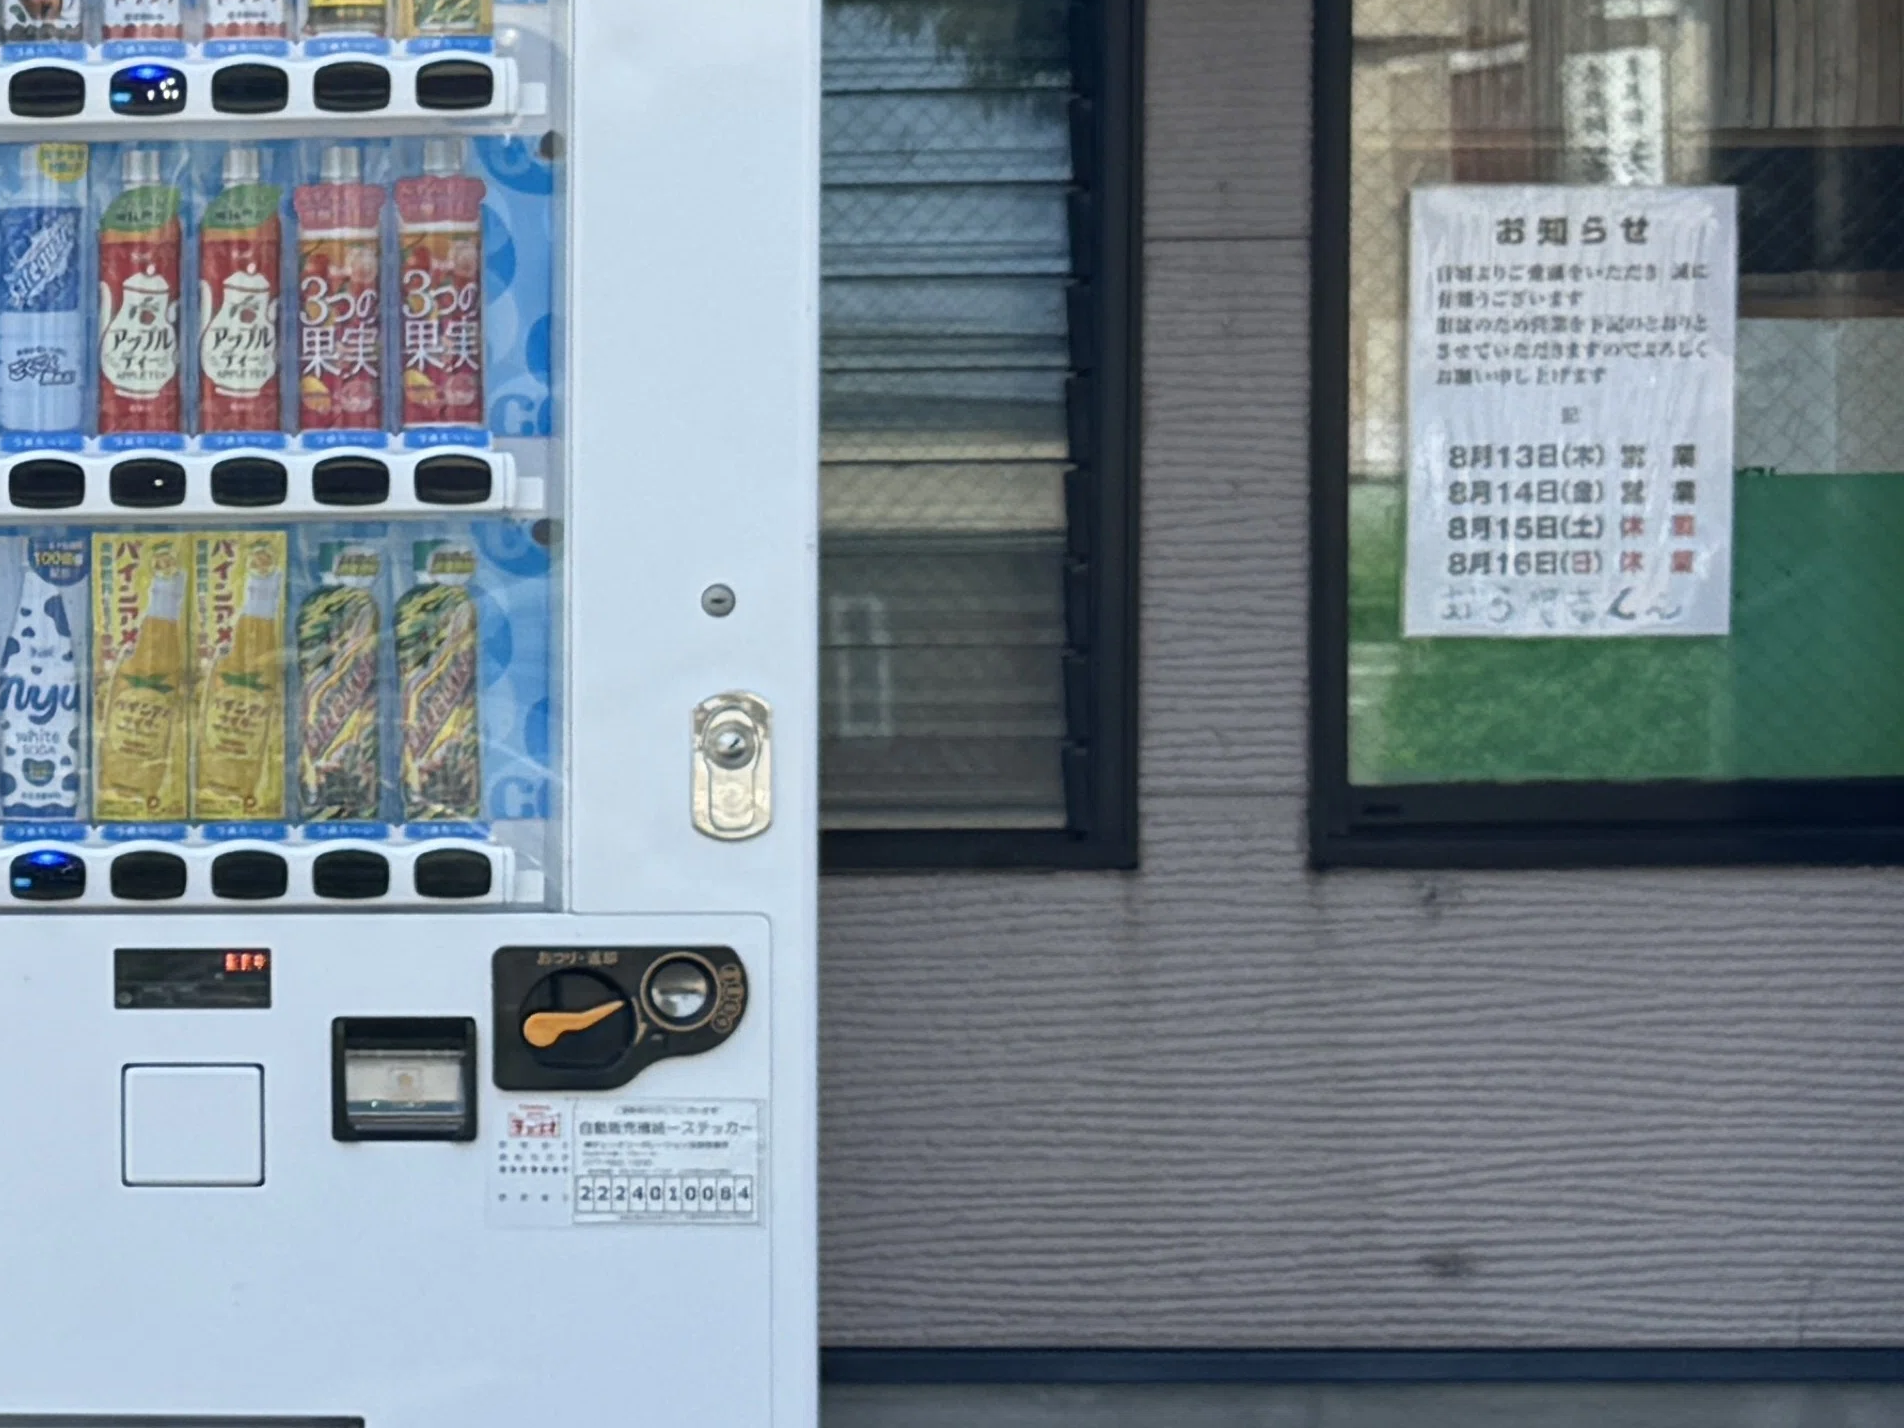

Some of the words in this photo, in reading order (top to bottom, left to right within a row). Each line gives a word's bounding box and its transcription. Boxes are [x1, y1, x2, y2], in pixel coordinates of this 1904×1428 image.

[1495, 216, 1649, 246] お知らせ
[299, 275, 377, 325] 3つの
[402, 269, 478, 319] 3つの
[112, 327, 173, 352] アップル
[212, 326, 273, 351] アップル
[302, 321, 378, 378] 果実
[404, 315, 480, 371] 果実
[1448, 443, 1605, 469] 8月13日(木)
[1448, 479, 1604, 505] 8月14日(金)
[1447, 514, 1604, 540] 8月15日(土)
[1447, 550, 1604, 575] 8月16日(日)
[15, 729, 60, 744] white
[579, 1185, 750, 1201] 2224010084
